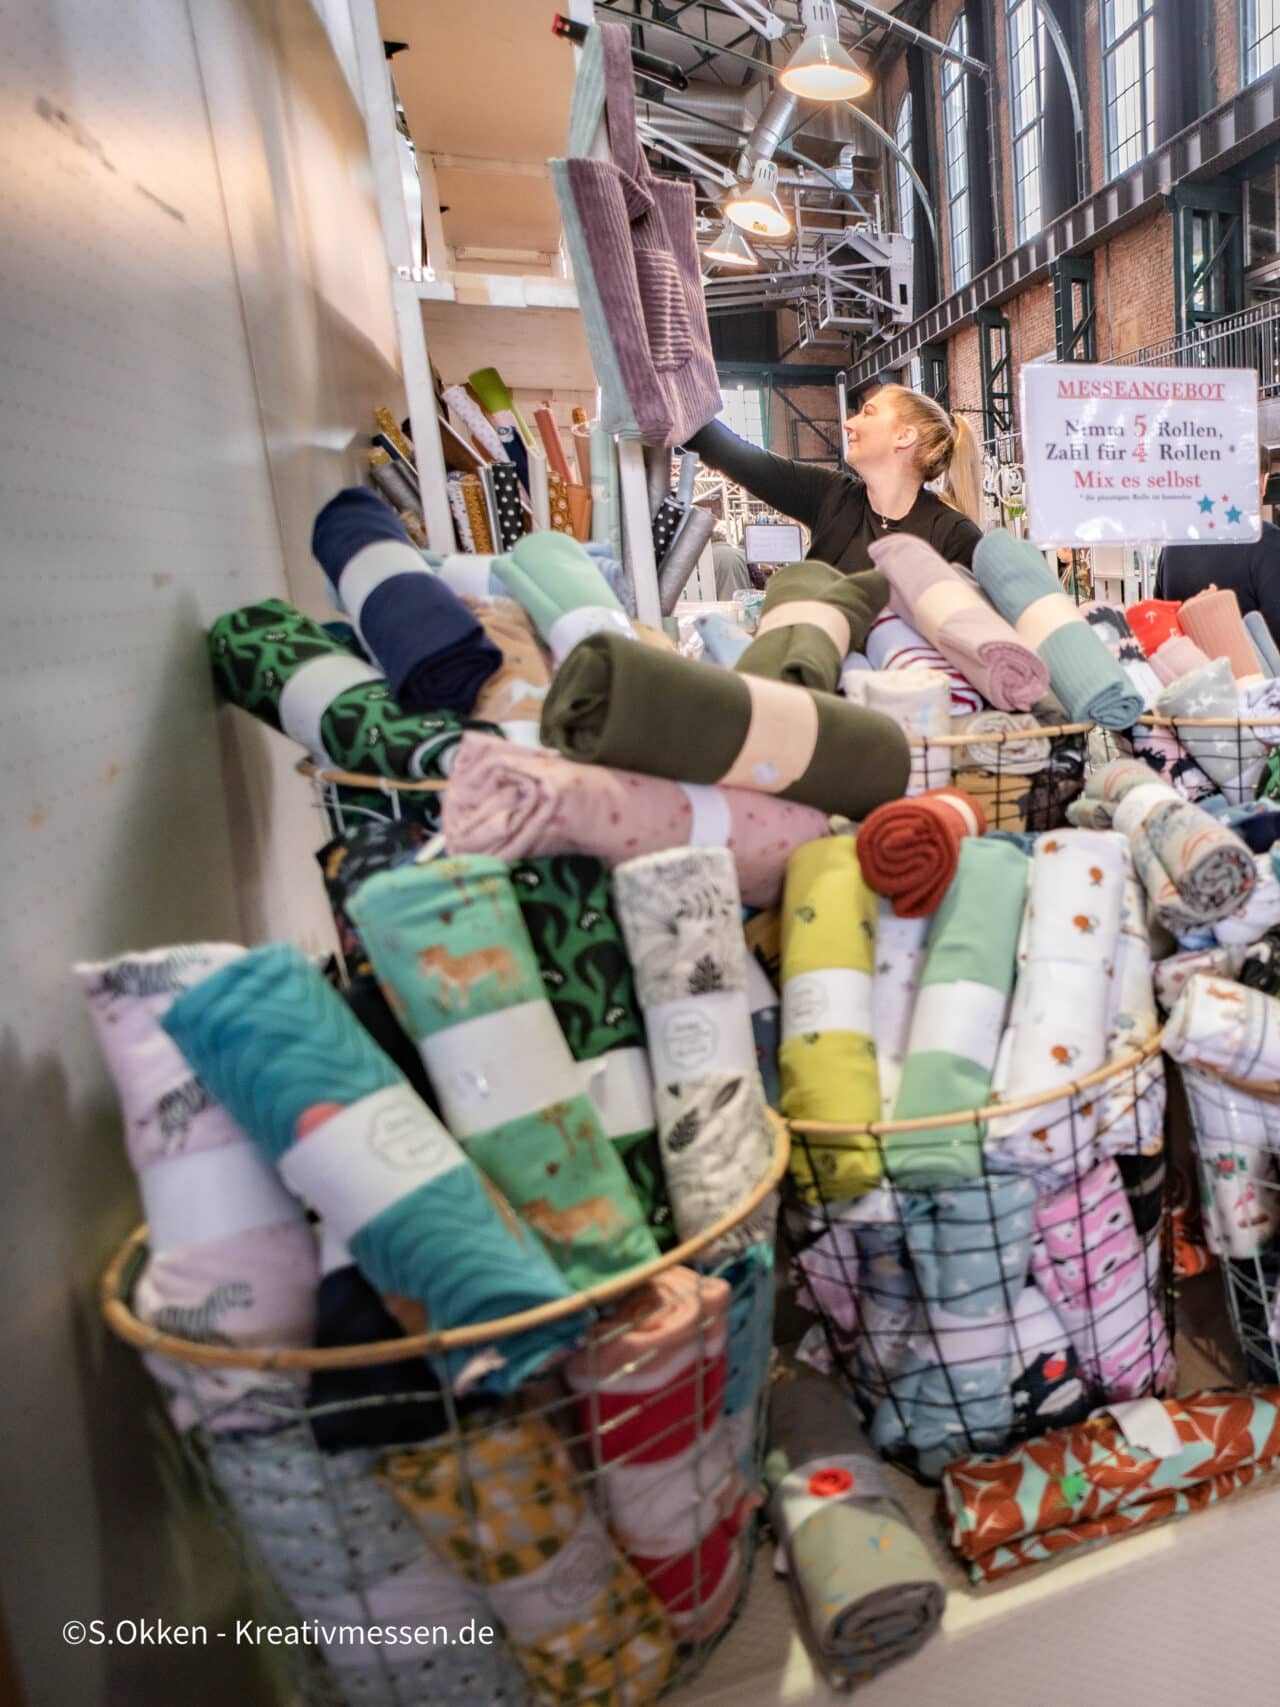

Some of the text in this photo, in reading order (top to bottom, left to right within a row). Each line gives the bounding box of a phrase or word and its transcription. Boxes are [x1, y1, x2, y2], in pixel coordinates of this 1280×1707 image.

[1057, 380, 1225, 399] MESSEANGEBOT
[1065, 414, 1223, 440] Nimm 5 Rollen,
[1045, 442, 1221, 464] Zahl für 4 Rollen
[1074, 470, 1201, 489] Mix es selbst
